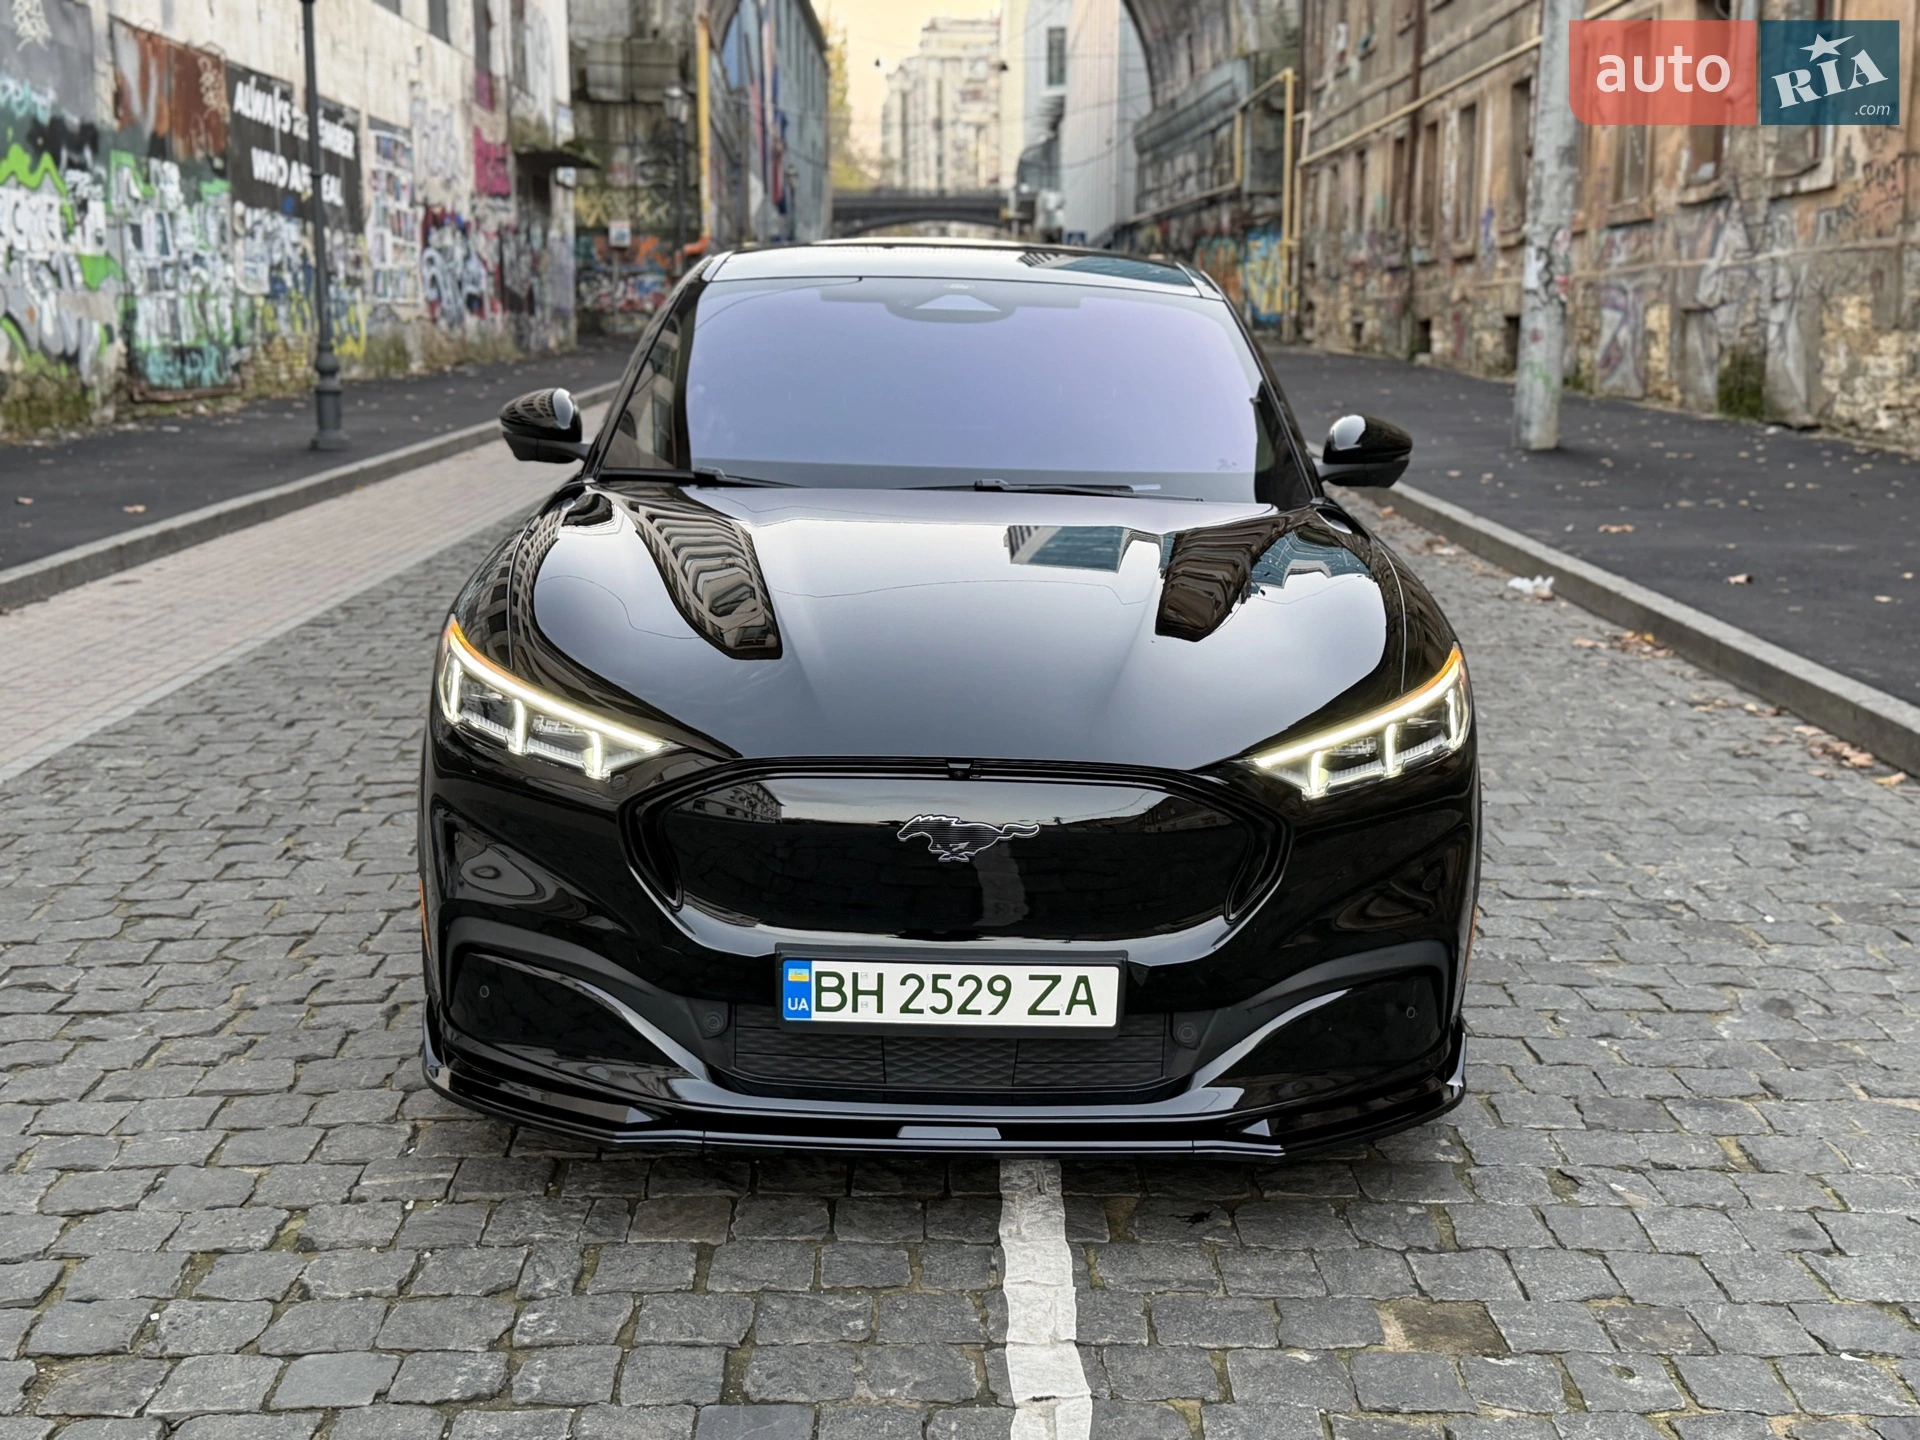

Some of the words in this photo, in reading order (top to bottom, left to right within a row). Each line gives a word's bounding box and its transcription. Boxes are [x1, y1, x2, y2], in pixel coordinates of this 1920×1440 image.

[233, 75, 291, 133] ALWAYS
[251, 147, 289, 188] WHO
[787, 997, 809, 1011] UA
[815, 971, 884, 1013] BH
[900, 973, 1012, 1015] 2529
[1027, 974, 1097, 1016] ZA
